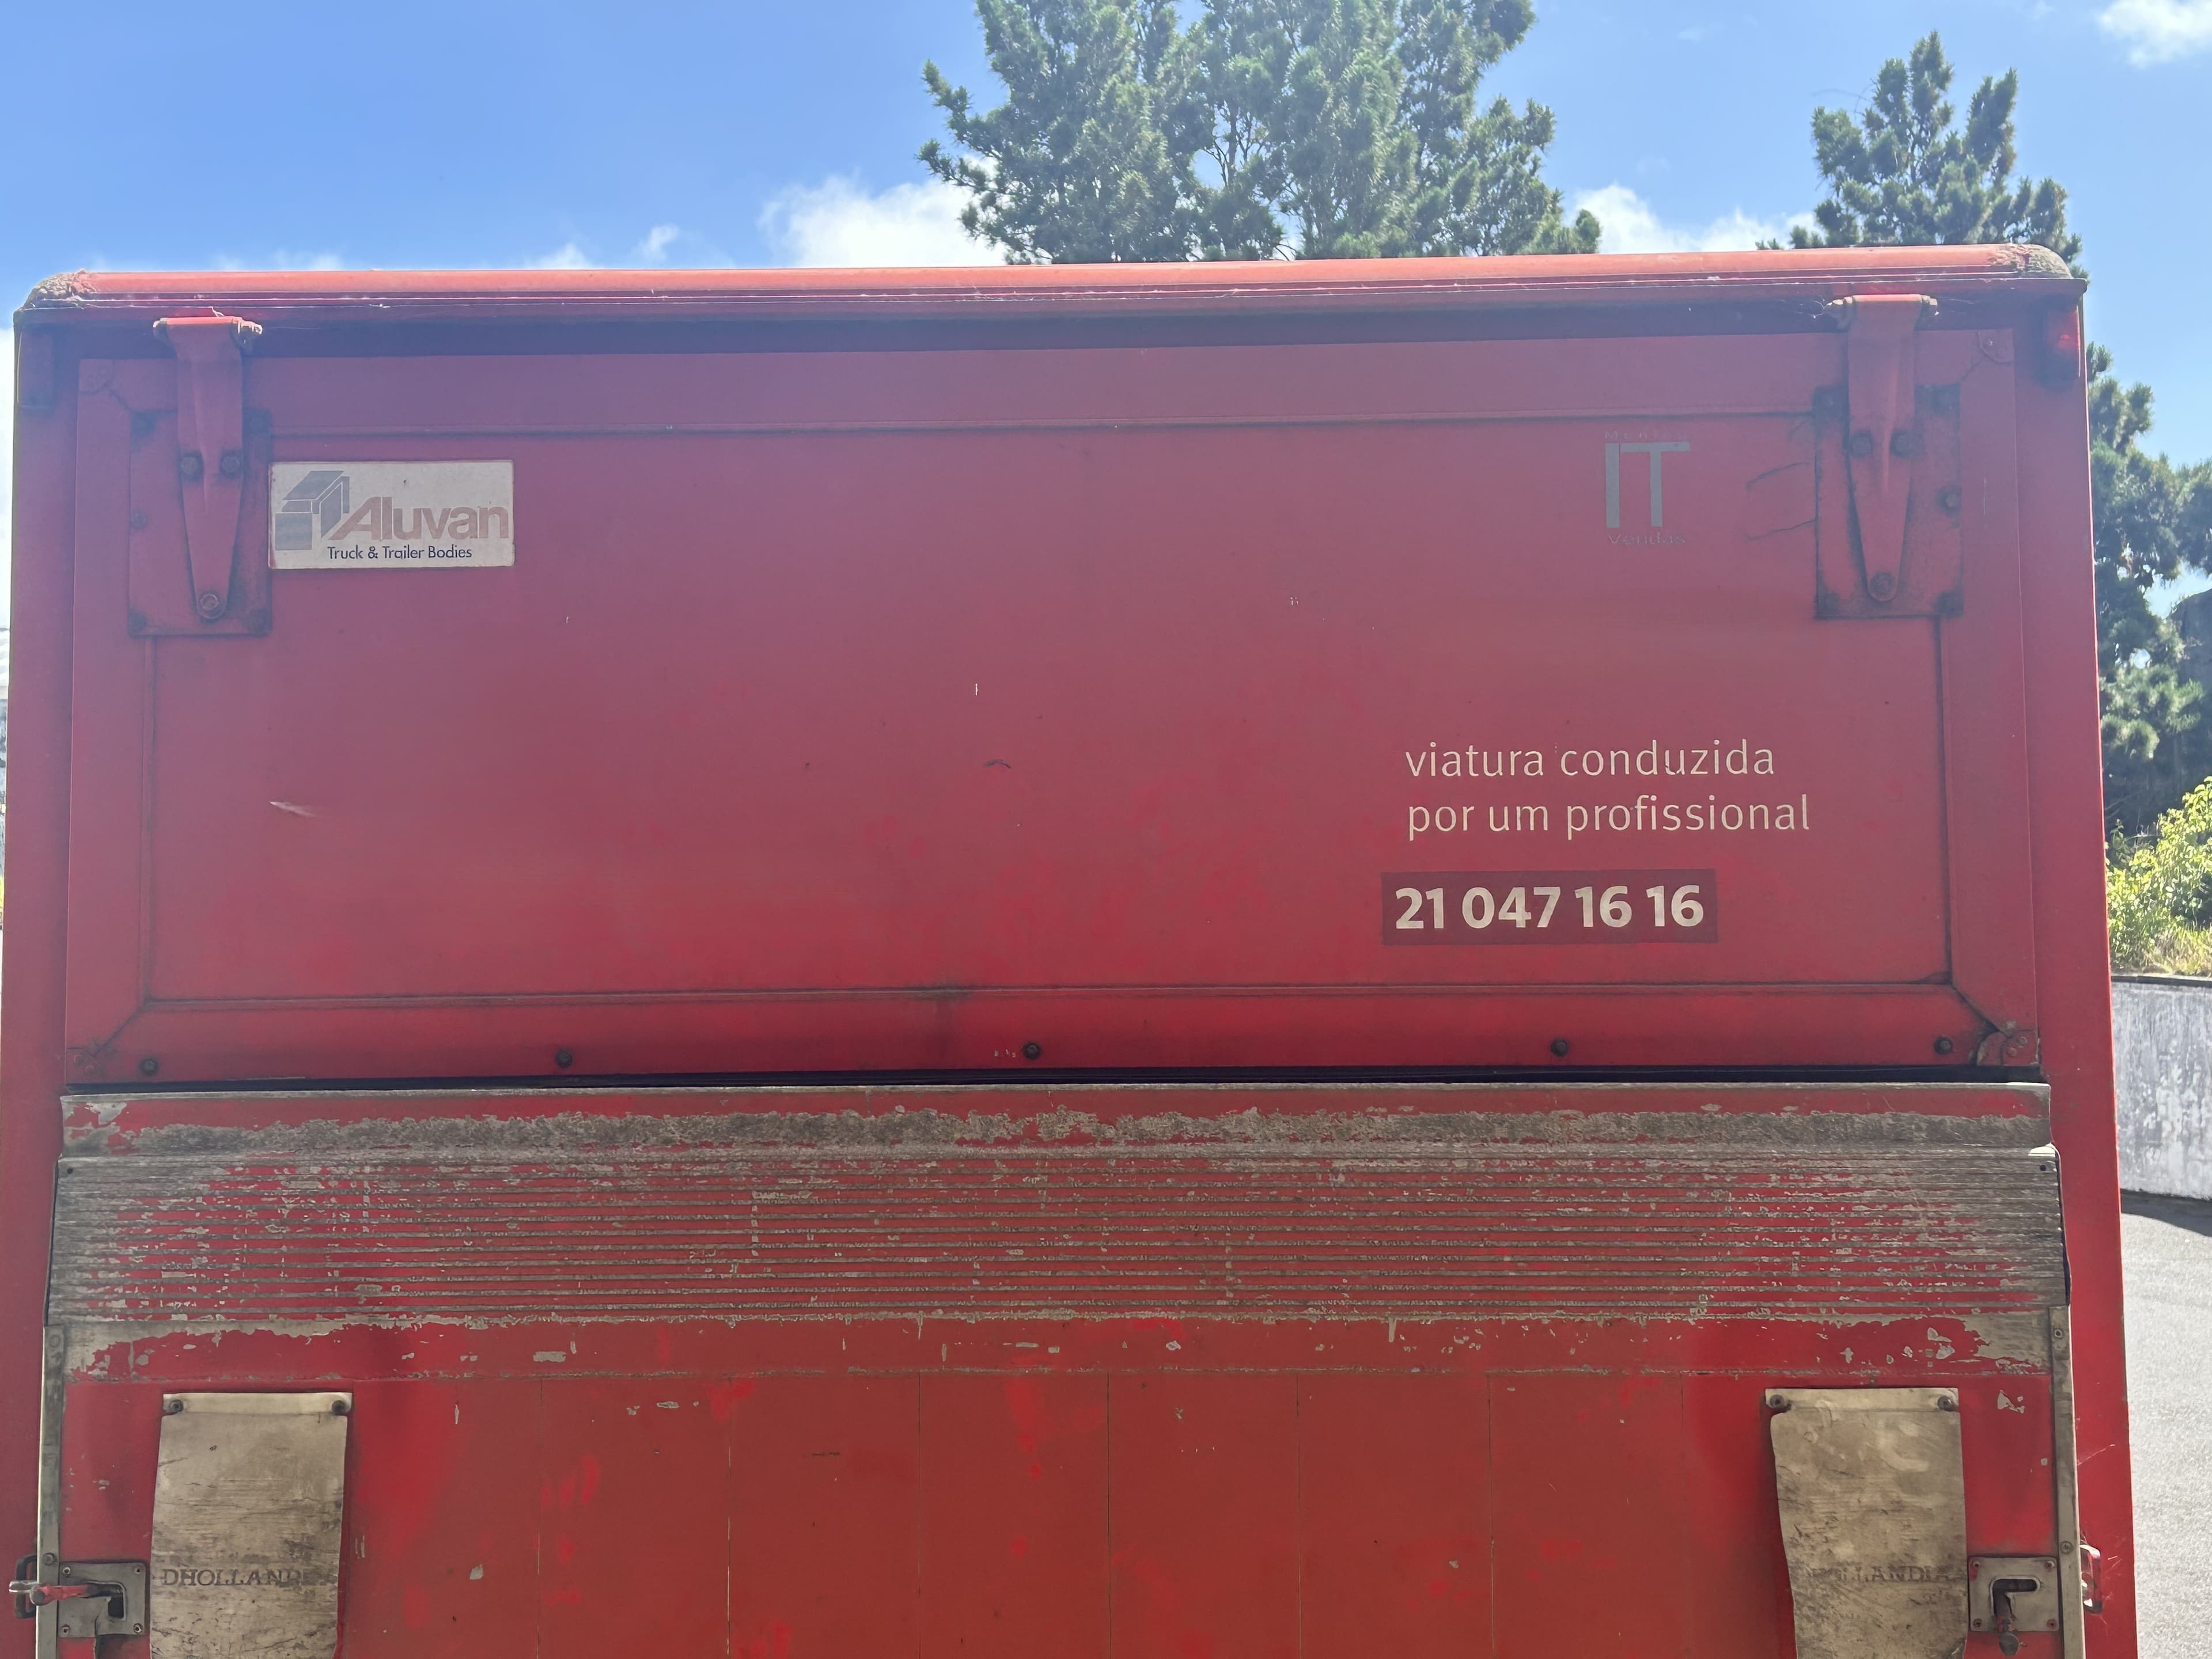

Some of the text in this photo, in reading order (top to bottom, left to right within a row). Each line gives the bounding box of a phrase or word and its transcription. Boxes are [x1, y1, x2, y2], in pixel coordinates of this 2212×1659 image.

[1605, 442, 1690, 528] IT
[327, 496, 510, 540] Aluvan
[327, 544, 472, 559] Truck & Trailer Bodies
[1406, 738, 1774, 777] viatura conduzida
[1409, 794, 1809, 841] por um profissional
[1396, 885, 1703, 929] 21 047 16 16
